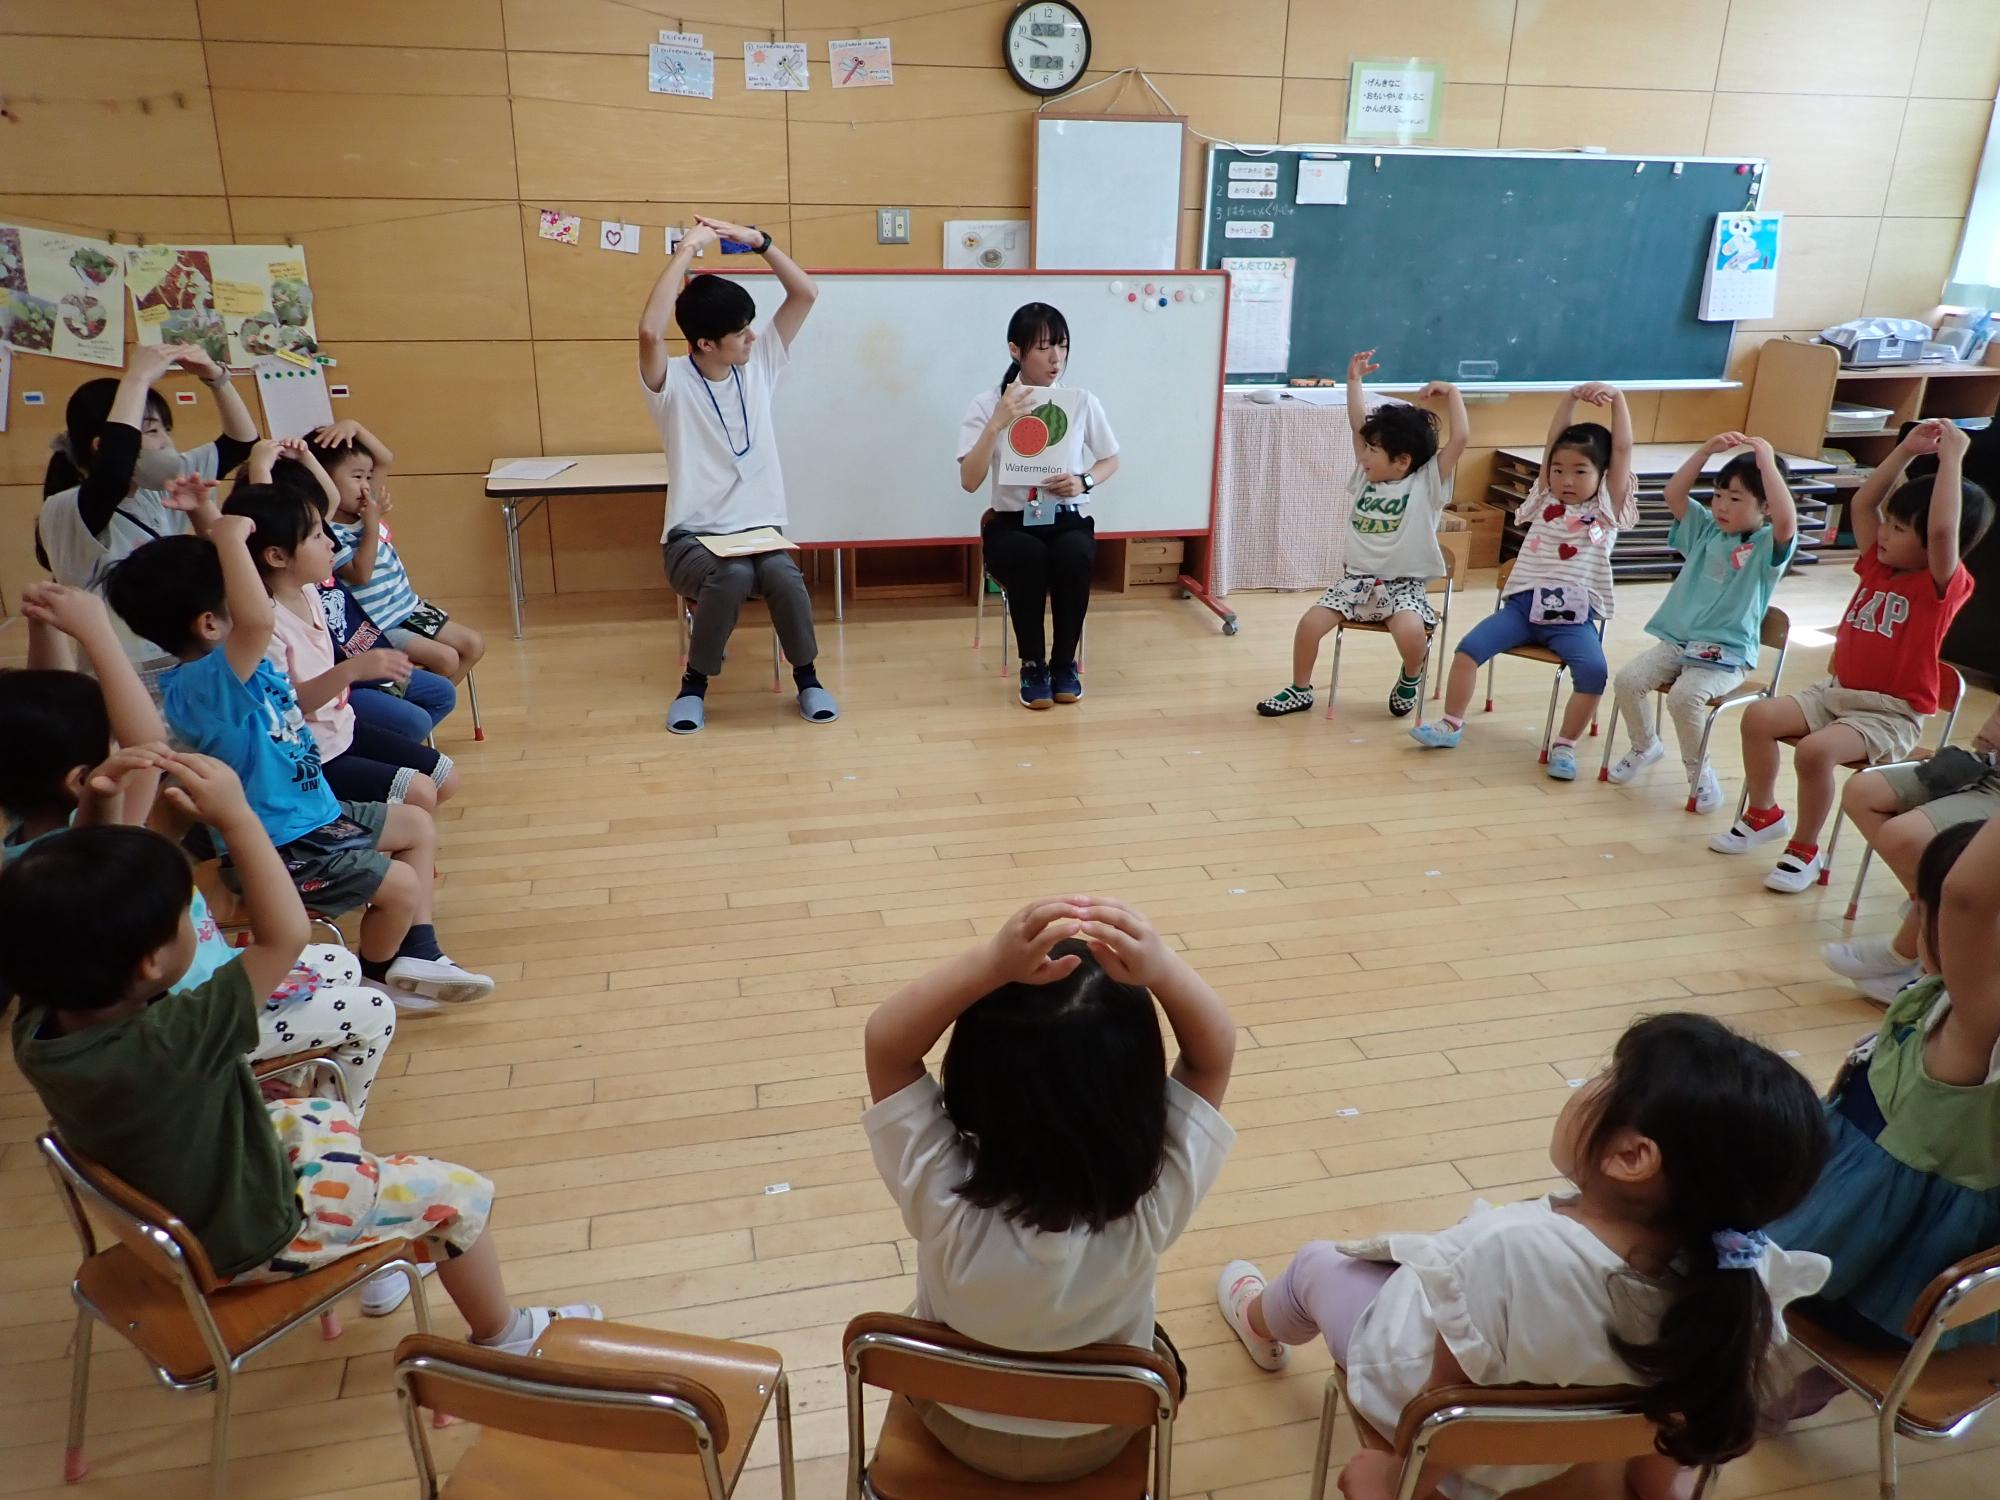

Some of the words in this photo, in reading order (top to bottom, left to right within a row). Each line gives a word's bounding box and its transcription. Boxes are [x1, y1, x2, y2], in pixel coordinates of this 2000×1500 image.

[1028, 12, 1036, 22] 11
[1044, 8, 1053, 18] 12
[1062, 14, 1065, 23] 1
[1018, 24, 1027, 35] 10
[1071, 27, 1077, 37] 2
[1013, 41, 1020, 50] 9
[1074, 44, 1080, 53] 3
[1018, 58, 1024, 67] 8
[1069, 60, 1075, 70] 4
[1029, 70, 1034, 79] 7
[1043, 74, 1049, 84] 6
[1058, 71, 1064, 80] 5
[1215, 184, 1223, 197] 2
[1229, 261, 1288, 271] こんだてひょう
[1005, 463, 1062, 474] Watermelon
